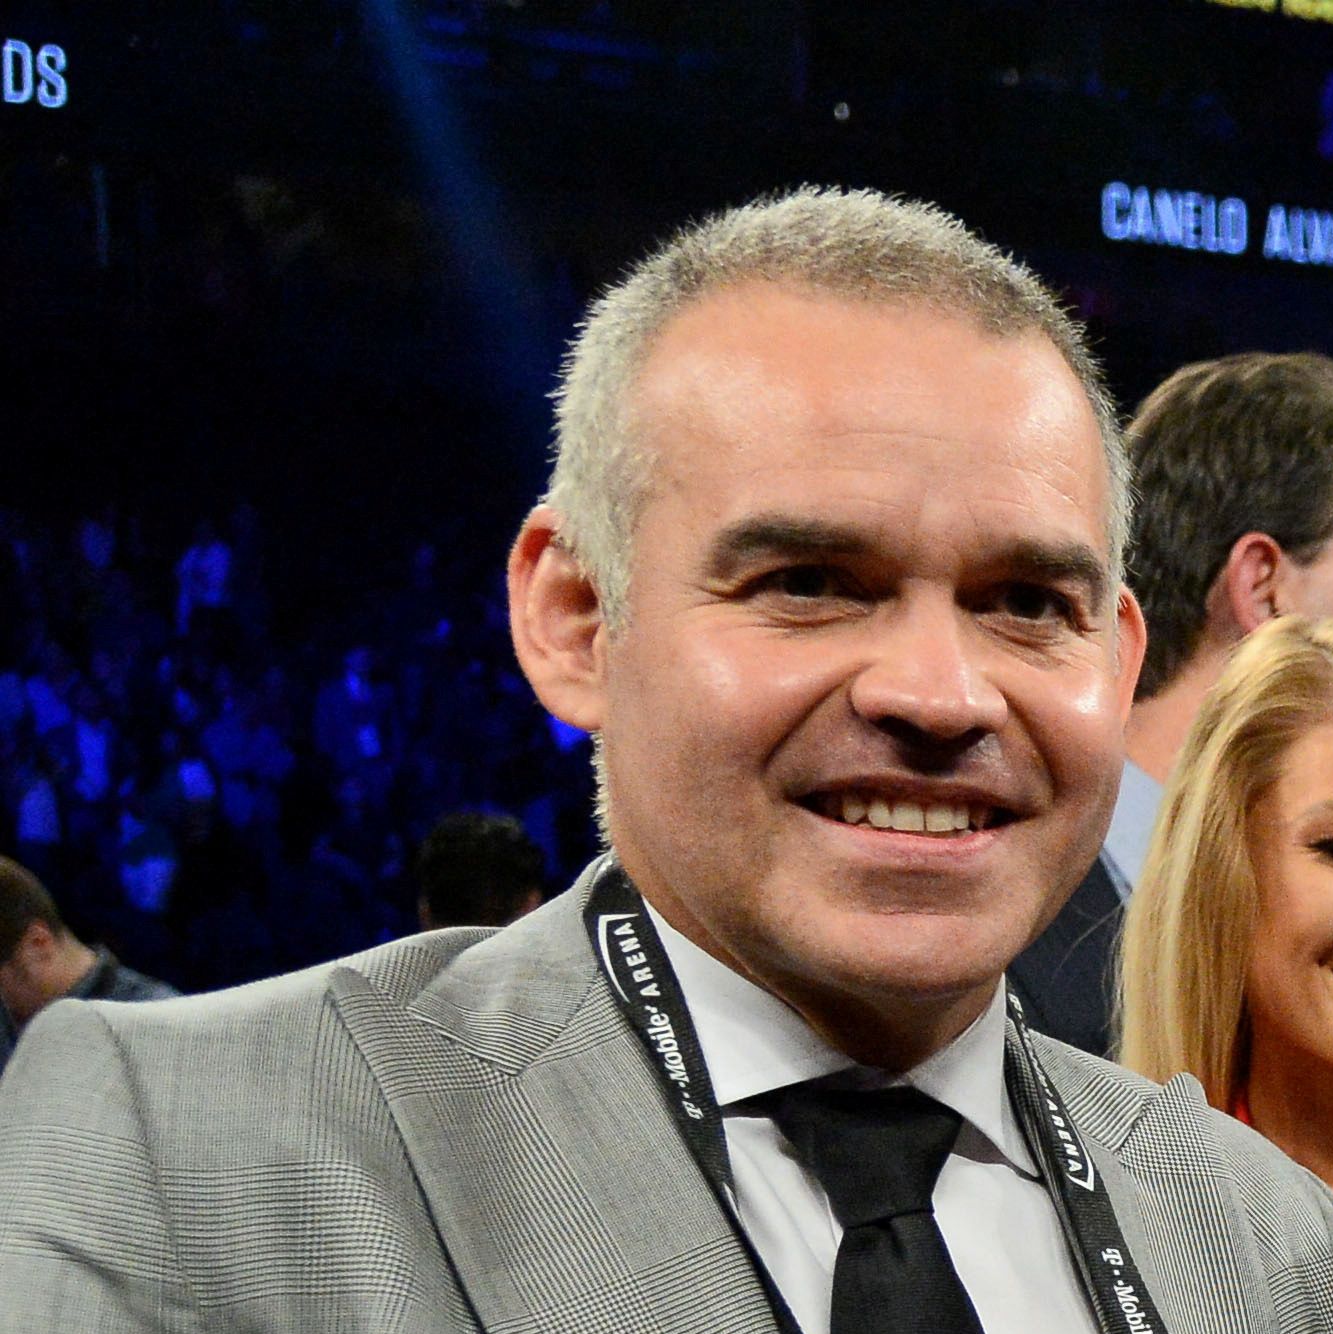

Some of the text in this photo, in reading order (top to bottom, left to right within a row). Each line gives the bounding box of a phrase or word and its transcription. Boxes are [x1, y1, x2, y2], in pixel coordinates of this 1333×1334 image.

[1102, 182, 1247, 254] CANELO
[614, 922, 662, 999] ARENA
[1046, 1099, 1083, 1174] ARENA
